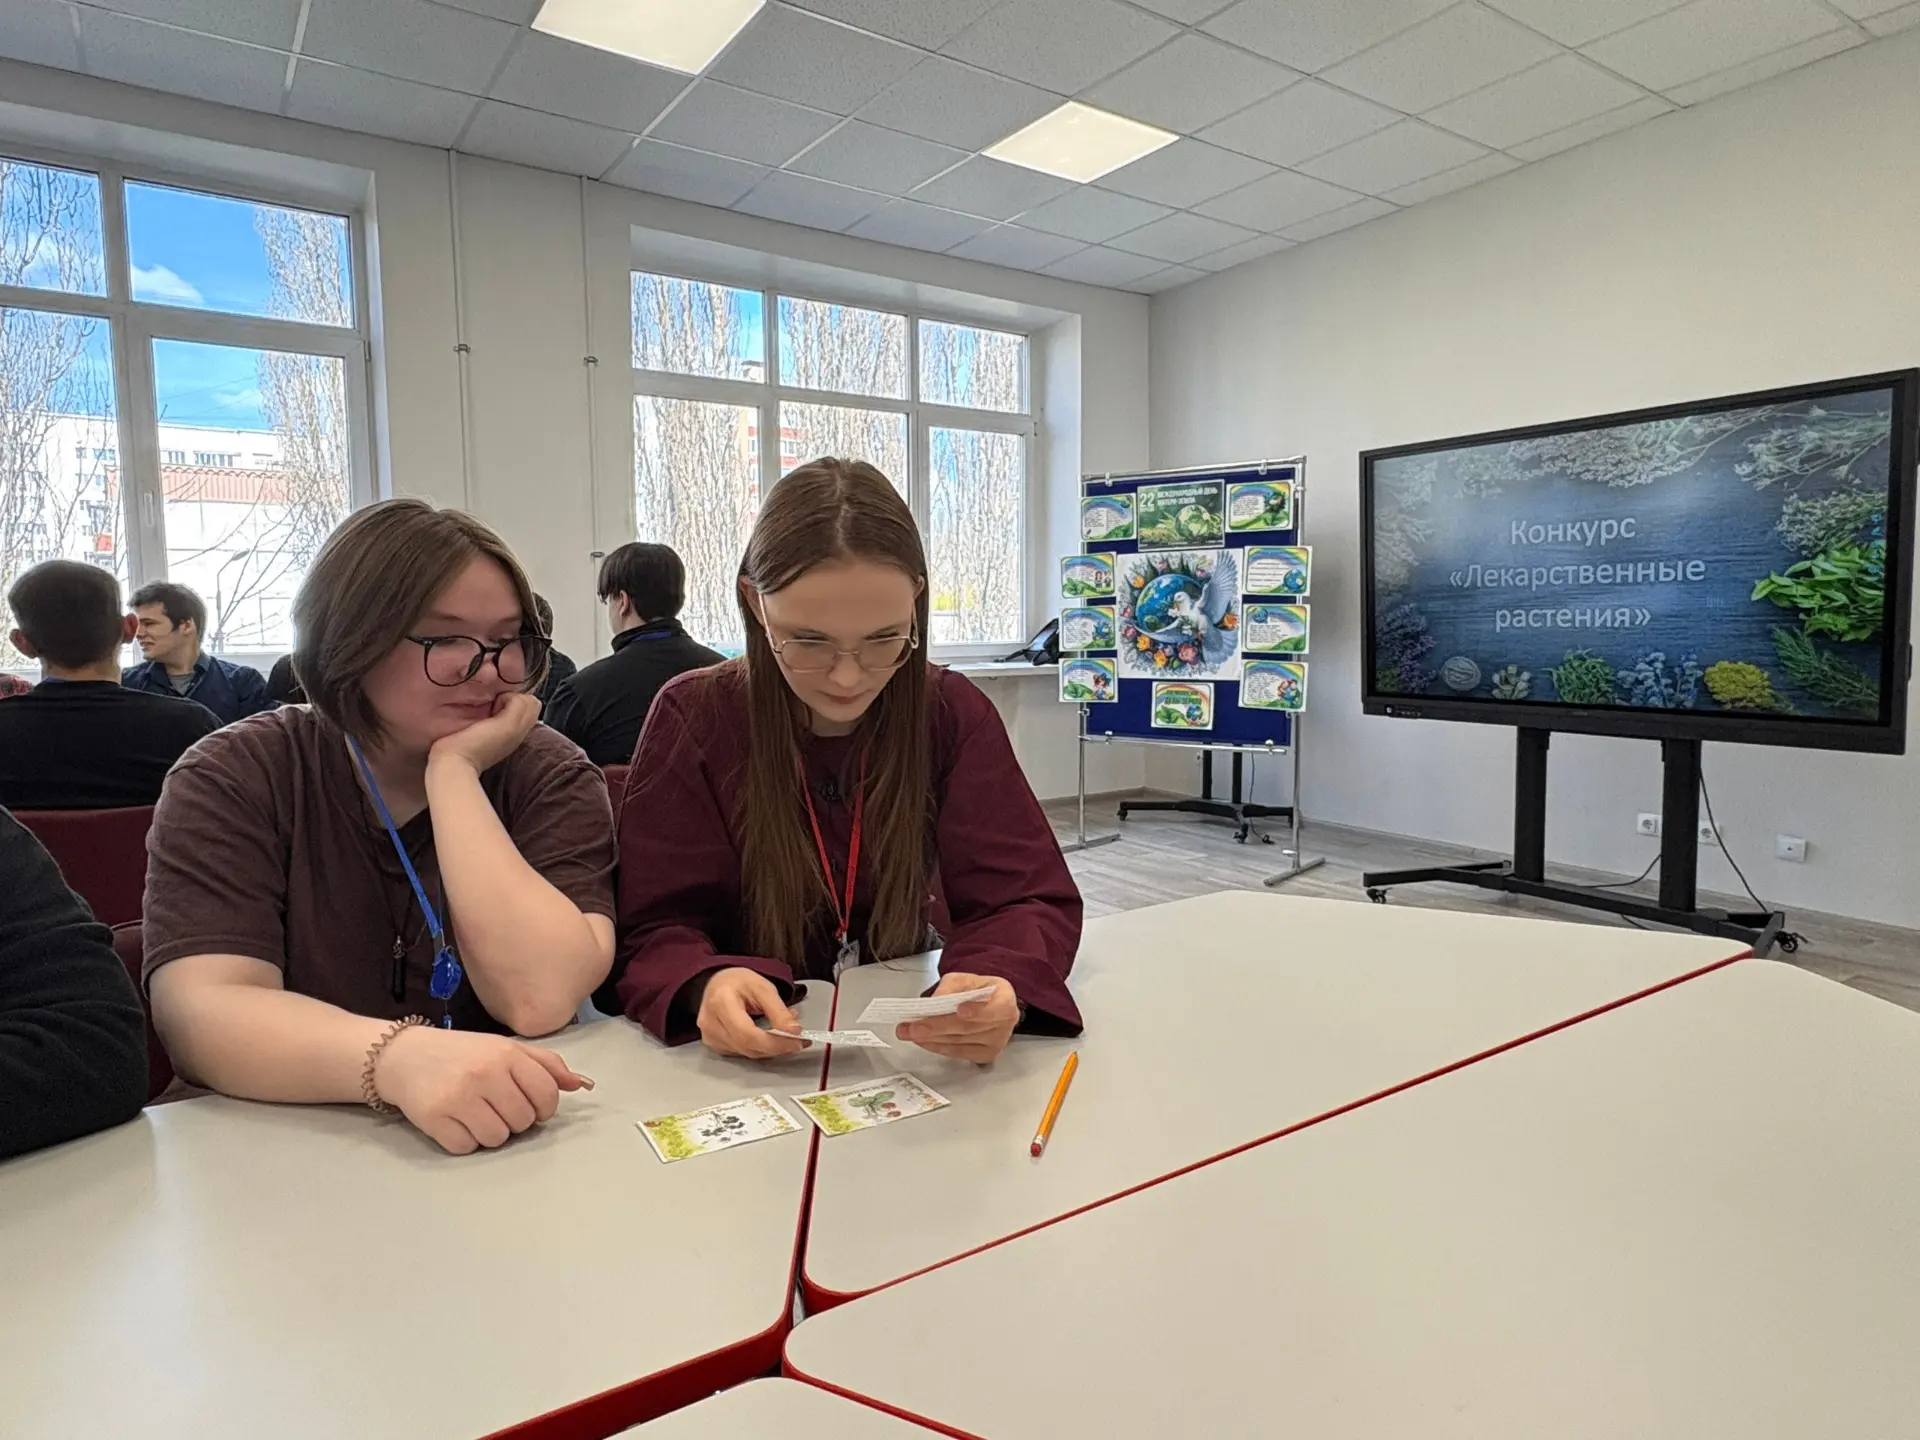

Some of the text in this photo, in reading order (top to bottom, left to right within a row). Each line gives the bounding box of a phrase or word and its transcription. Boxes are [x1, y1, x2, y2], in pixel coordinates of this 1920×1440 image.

[1139, 492, 1155, 507] 22
[1511, 516, 1636, 546] Конкурс
[1449, 558, 1706, 591] «Лекарственные
[1495, 607, 1651, 633] растения»
